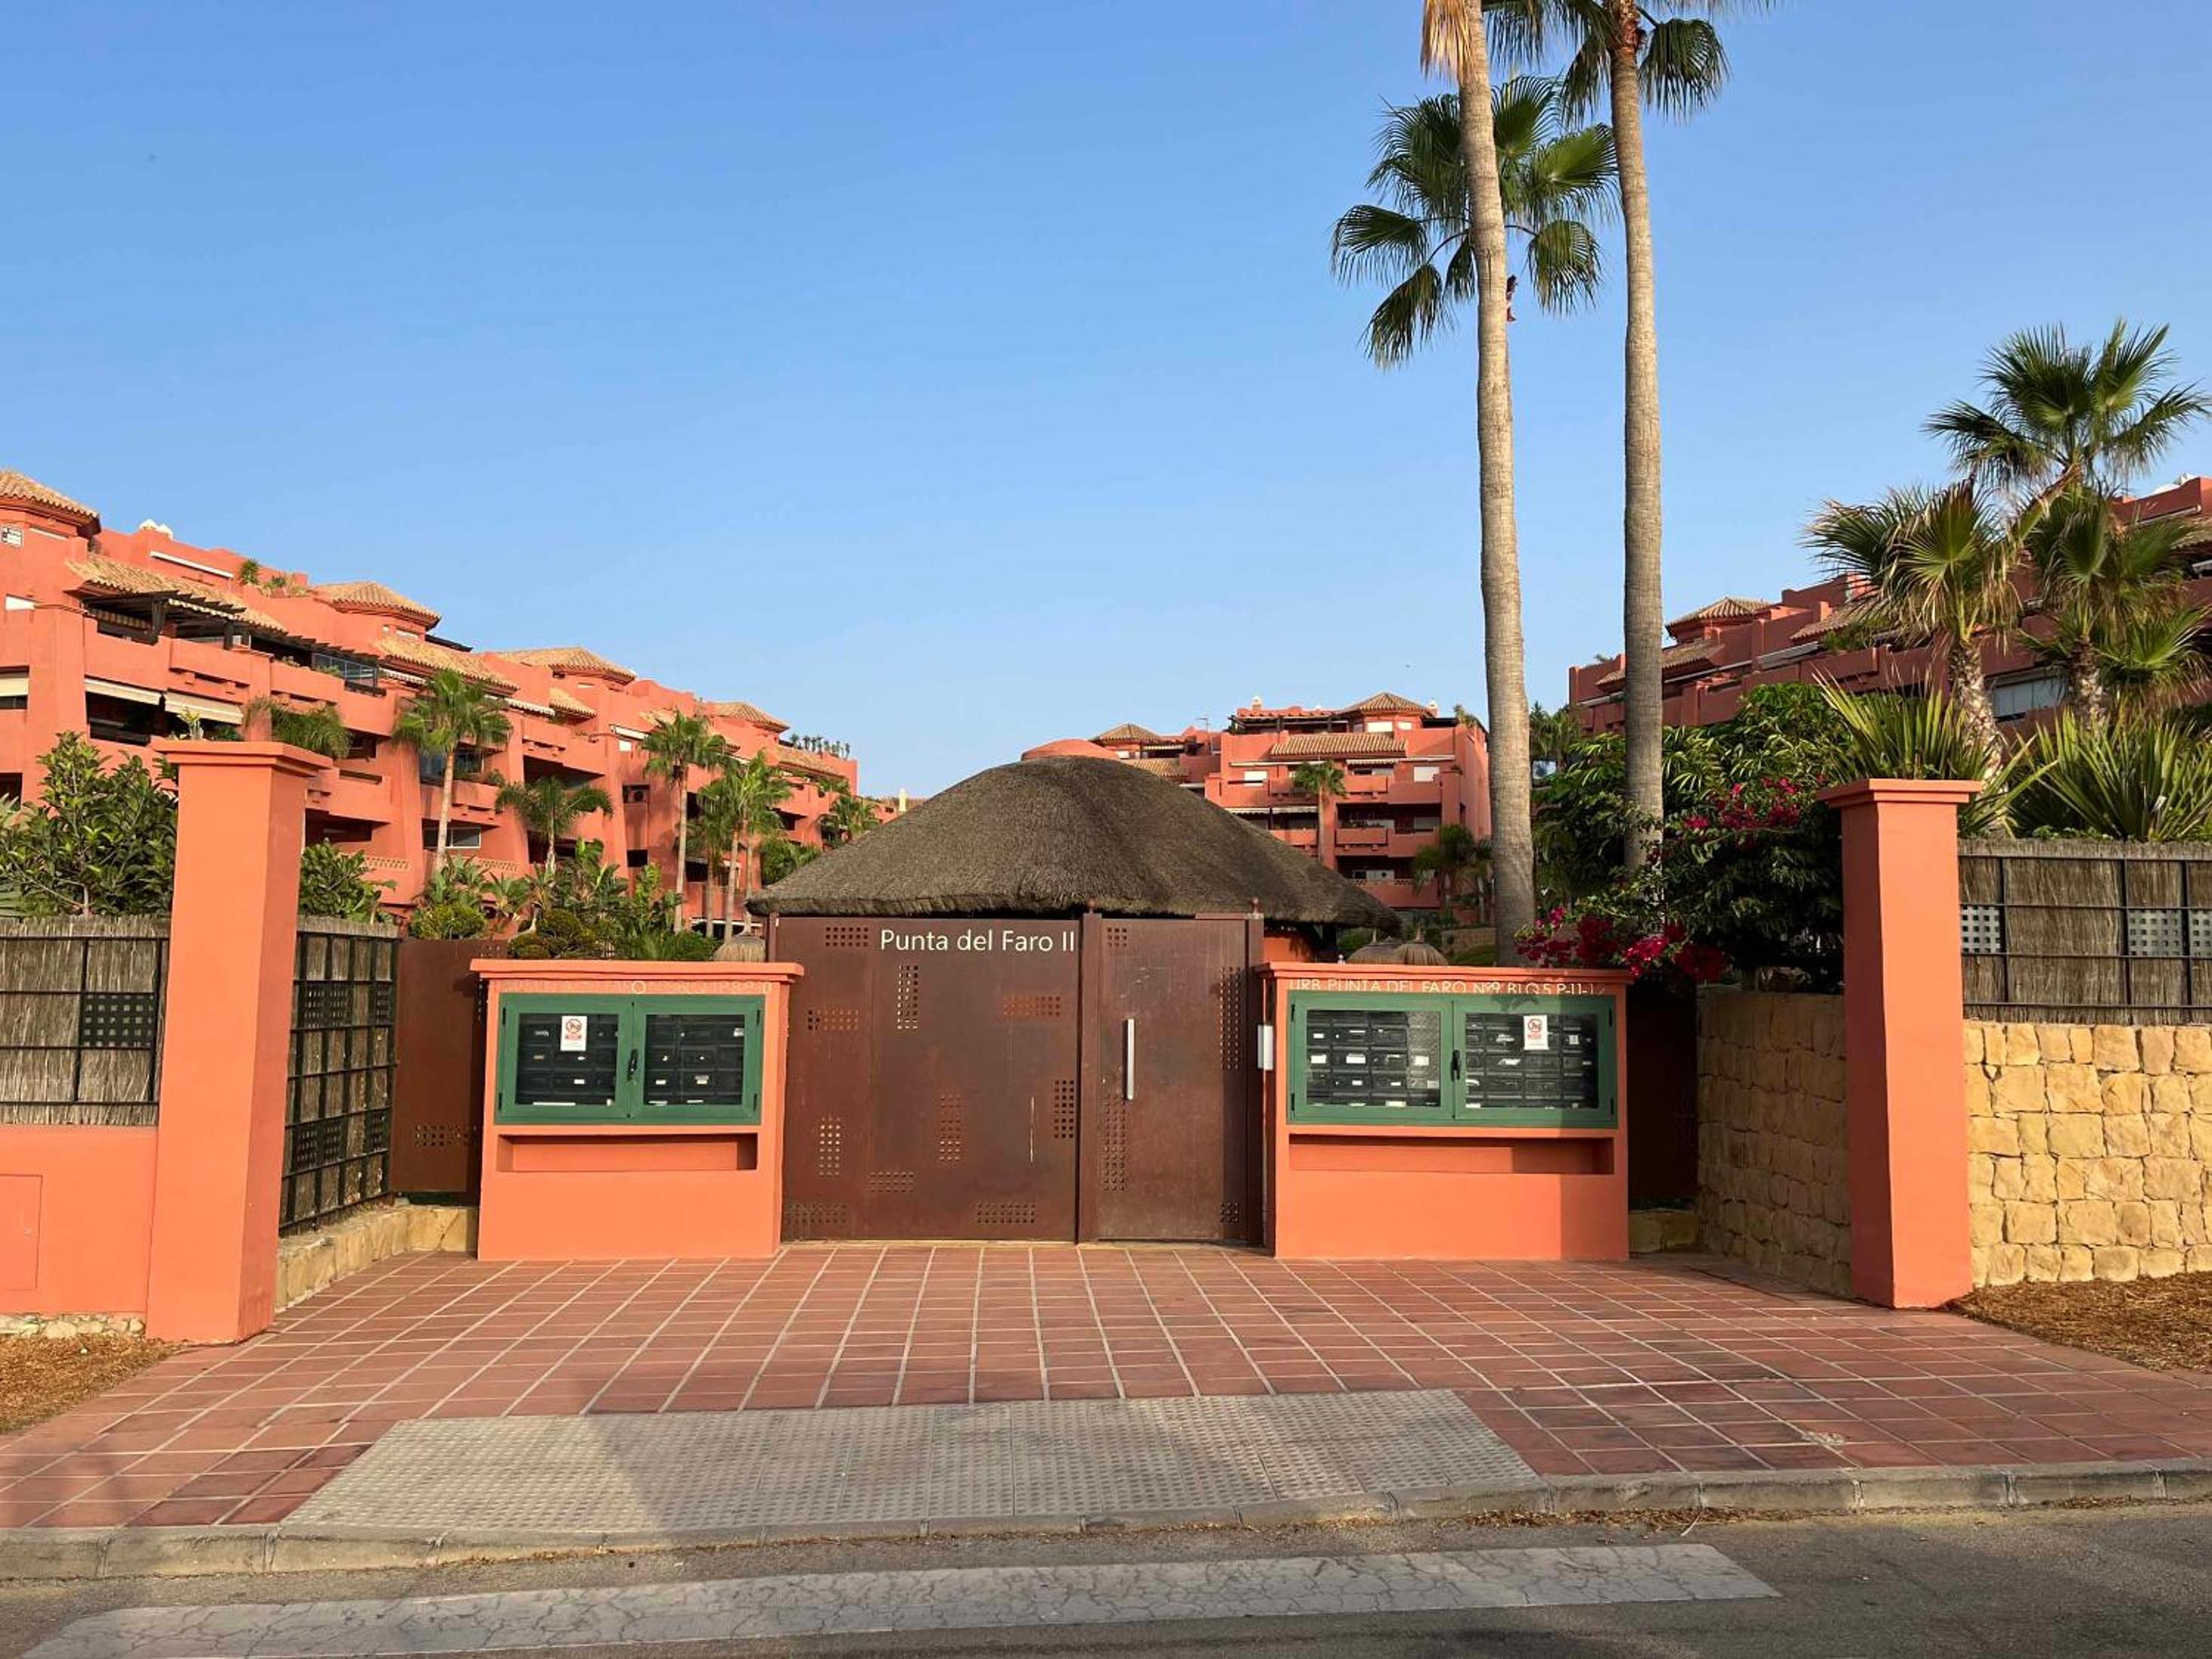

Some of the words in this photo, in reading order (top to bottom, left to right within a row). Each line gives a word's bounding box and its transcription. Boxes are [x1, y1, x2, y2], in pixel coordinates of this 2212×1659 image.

[880, 929, 948, 951] Punta
[957, 928, 992, 952] del
[1002, 930, 1054, 952] Faro
[1062, 931, 1075, 952] II
[1327, 980, 1382, 992] PUNTA
[1422, 981, 1467, 994] FARO
